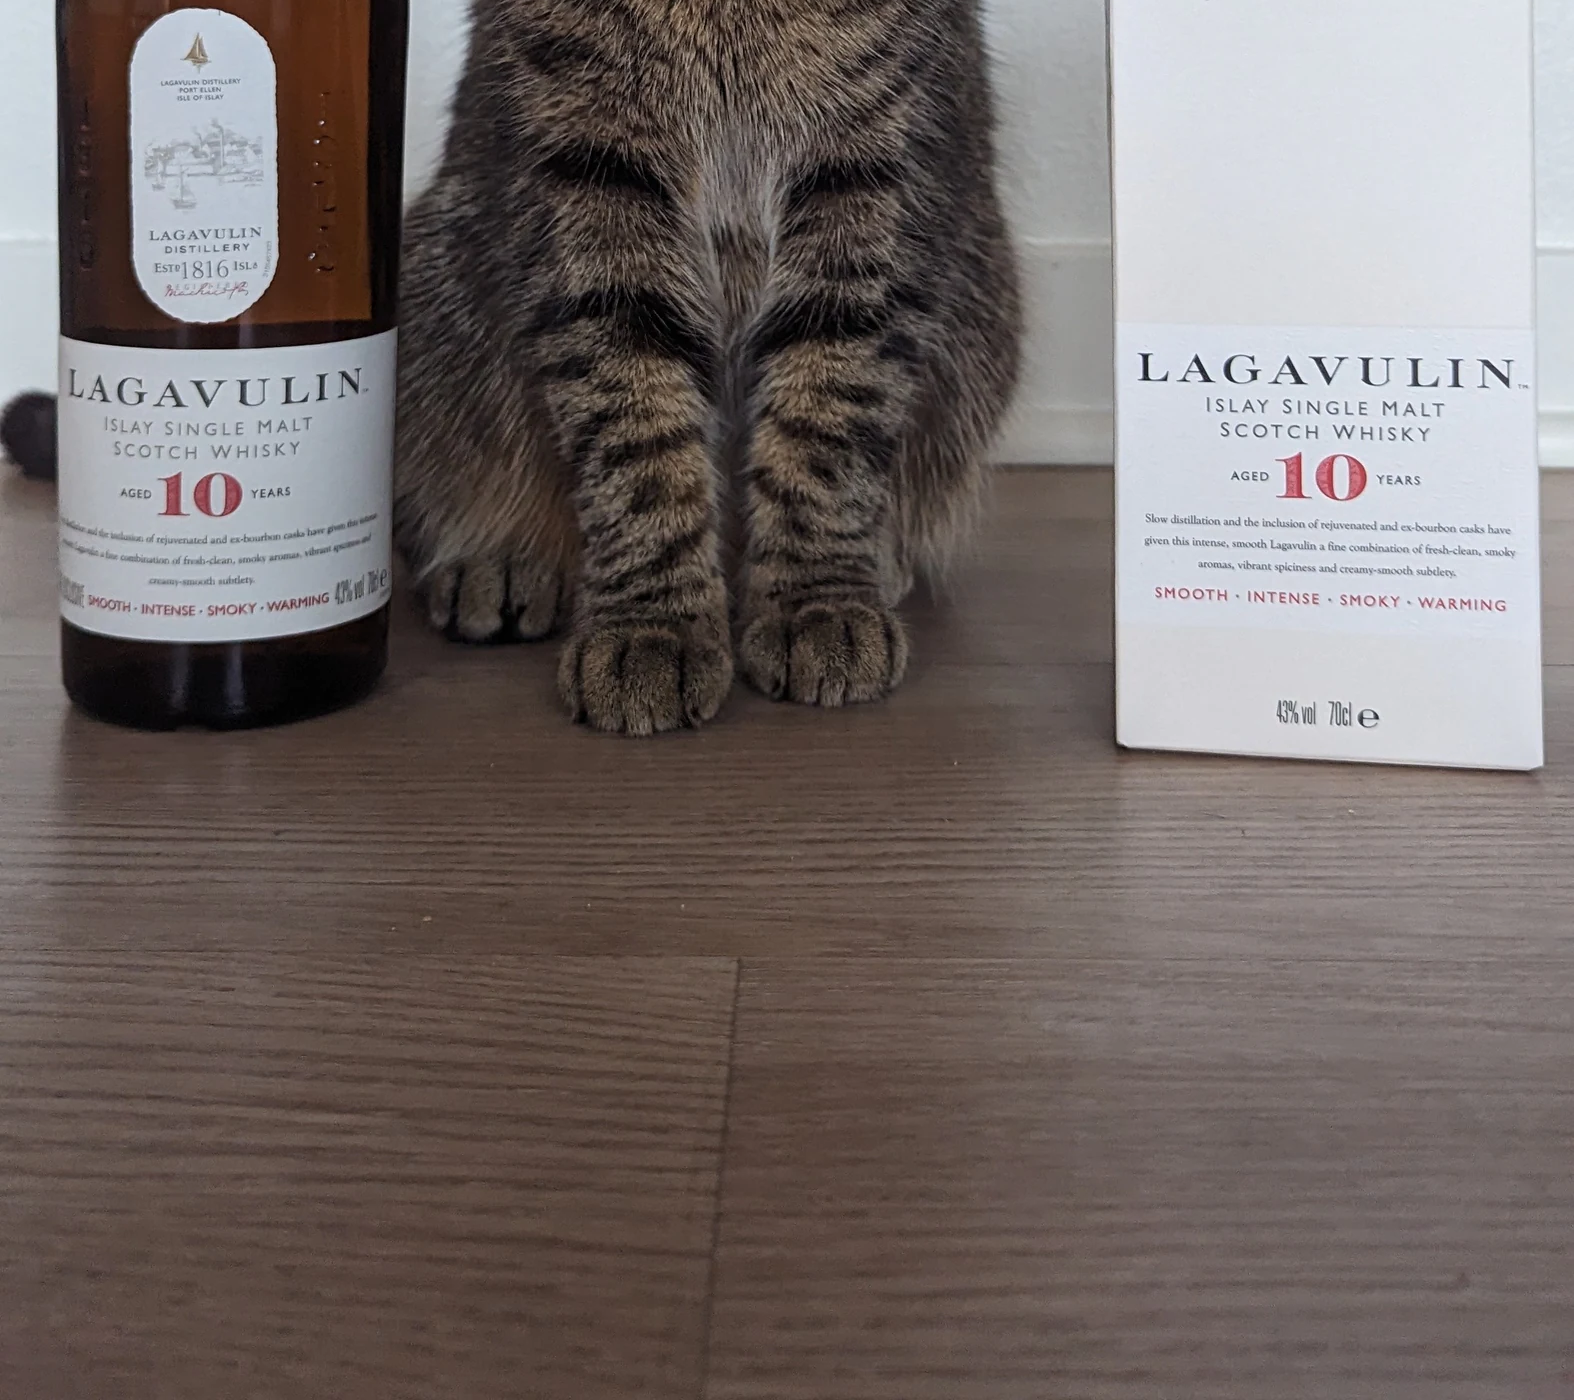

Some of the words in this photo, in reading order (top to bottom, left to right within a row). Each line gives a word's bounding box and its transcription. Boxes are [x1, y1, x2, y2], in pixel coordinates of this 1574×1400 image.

[160, 79, 200, 87] LAGAVULIN
[202, 78, 241, 86] DISTILLERY
[149, 226, 262, 242] LAGAVULIN
[165, 243, 250, 255] DISTILLERY
[182, 259, 229, 280] 1816
[1137, 352, 1515, 390] LAGAVULIN
[69, 367, 362, 408] LAGAVULIN
[1206, 396, 1269, 414] ISLAY
[1282, 399, 1369, 416] SINGLE
[1382, 401, 1446, 418] MALT
[104, 416, 154, 435] ISLAY
[164, 420, 245, 436] SINGLE
[257, 416, 313, 435] MALT
[1220, 421, 1319, 440] SCOTCH
[1332, 424, 1431, 443] WHISKY
[113, 441, 198, 460] SCOTCH
[211, 441, 301, 460] WHISKY
[1230, 469, 1270, 482] AGED
[1275, 451, 1368, 502] 10
[1376, 473, 1421, 486] YEARS
[120, 487, 152, 500] AGED
[156, 470, 244, 518] 10
[251, 486, 292, 499] YEARS
[146, 533, 156, 543] of
[156, 534, 208, 546] rejuvenated
[210, 535, 227, 545] and
[230, 532, 281, 545] ex-bourbon
[283, 529, 305, 540] casks
[307, 526, 326, 537] have
[327, 522, 346, 535] given
[1145, 513, 1168, 525] Slow
[1170, 514, 1221, 526] distillation
[1223, 517, 1241, 527] and
[1244, 517, 1259, 527] the
[1262, 517, 1306, 528] inclusion
[1308, 518, 1319, 529] of
[1320, 520, 1377, 531] rejuvenated
[1379, 521, 1398, 531] and
[1400, 522, 1457, 533] ex-bourbon
[1459, 524, 1485, 534] casks
[1487, 525, 1512, 535] have
[120, 553, 170, 565] combination
[172, 555, 182, 566] of
[183, 555, 236, 567] fresh-clean,
[238, 553, 266, 565] smoky
[305, 545, 332, 557] vibrant
[1144, 536, 1170, 547] given
[1172, 536, 1190, 547] this
[1192, 537, 1229, 549] intense,
[1231, 538, 1267, 550] smooth
[1270, 539, 1317, 551] Lagavulin
[1319, 543, 1326, 551] a
[1328, 541, 1346, 552] fine
[1348, 542, 1410, 554] combination
[1412, 543, 1425, 554] of
[1425, 543, 1482, 557] fresh-clean,
[1484, 546, 1516, 559] smoky
[1198, 559, 1235, 571] aromas,
[1237, 560, 1272, 571] vibrant
[1274, 561, 1316, 574] spiciness
[1319, 563, 1337, 573] and
[1339, 563, 1413, 577] creamy-smooth
[1416, 566, 1457, 578] subtlety.
[218, 575, 255, 586] subtlety.
[88, 594, 131, 613] SMOOTH
[141, 603, 196, 617] INTENSE
[207, 602, 257, 617] SMOKY
[267, 592, 330, 612] WARMING
[1155, 586, 1228, 601] SMOOTH
[1247, 589, 1320, 605] INTENSE
[1339, 593, 1400, 608] SMOKY
[1417, 596, 1507, 612] WARMING
[1276, 699, 1300, 725] 43%
[1301, 702, 1316, 726] vol
[1328, 700, 1352, 727] 70cl
